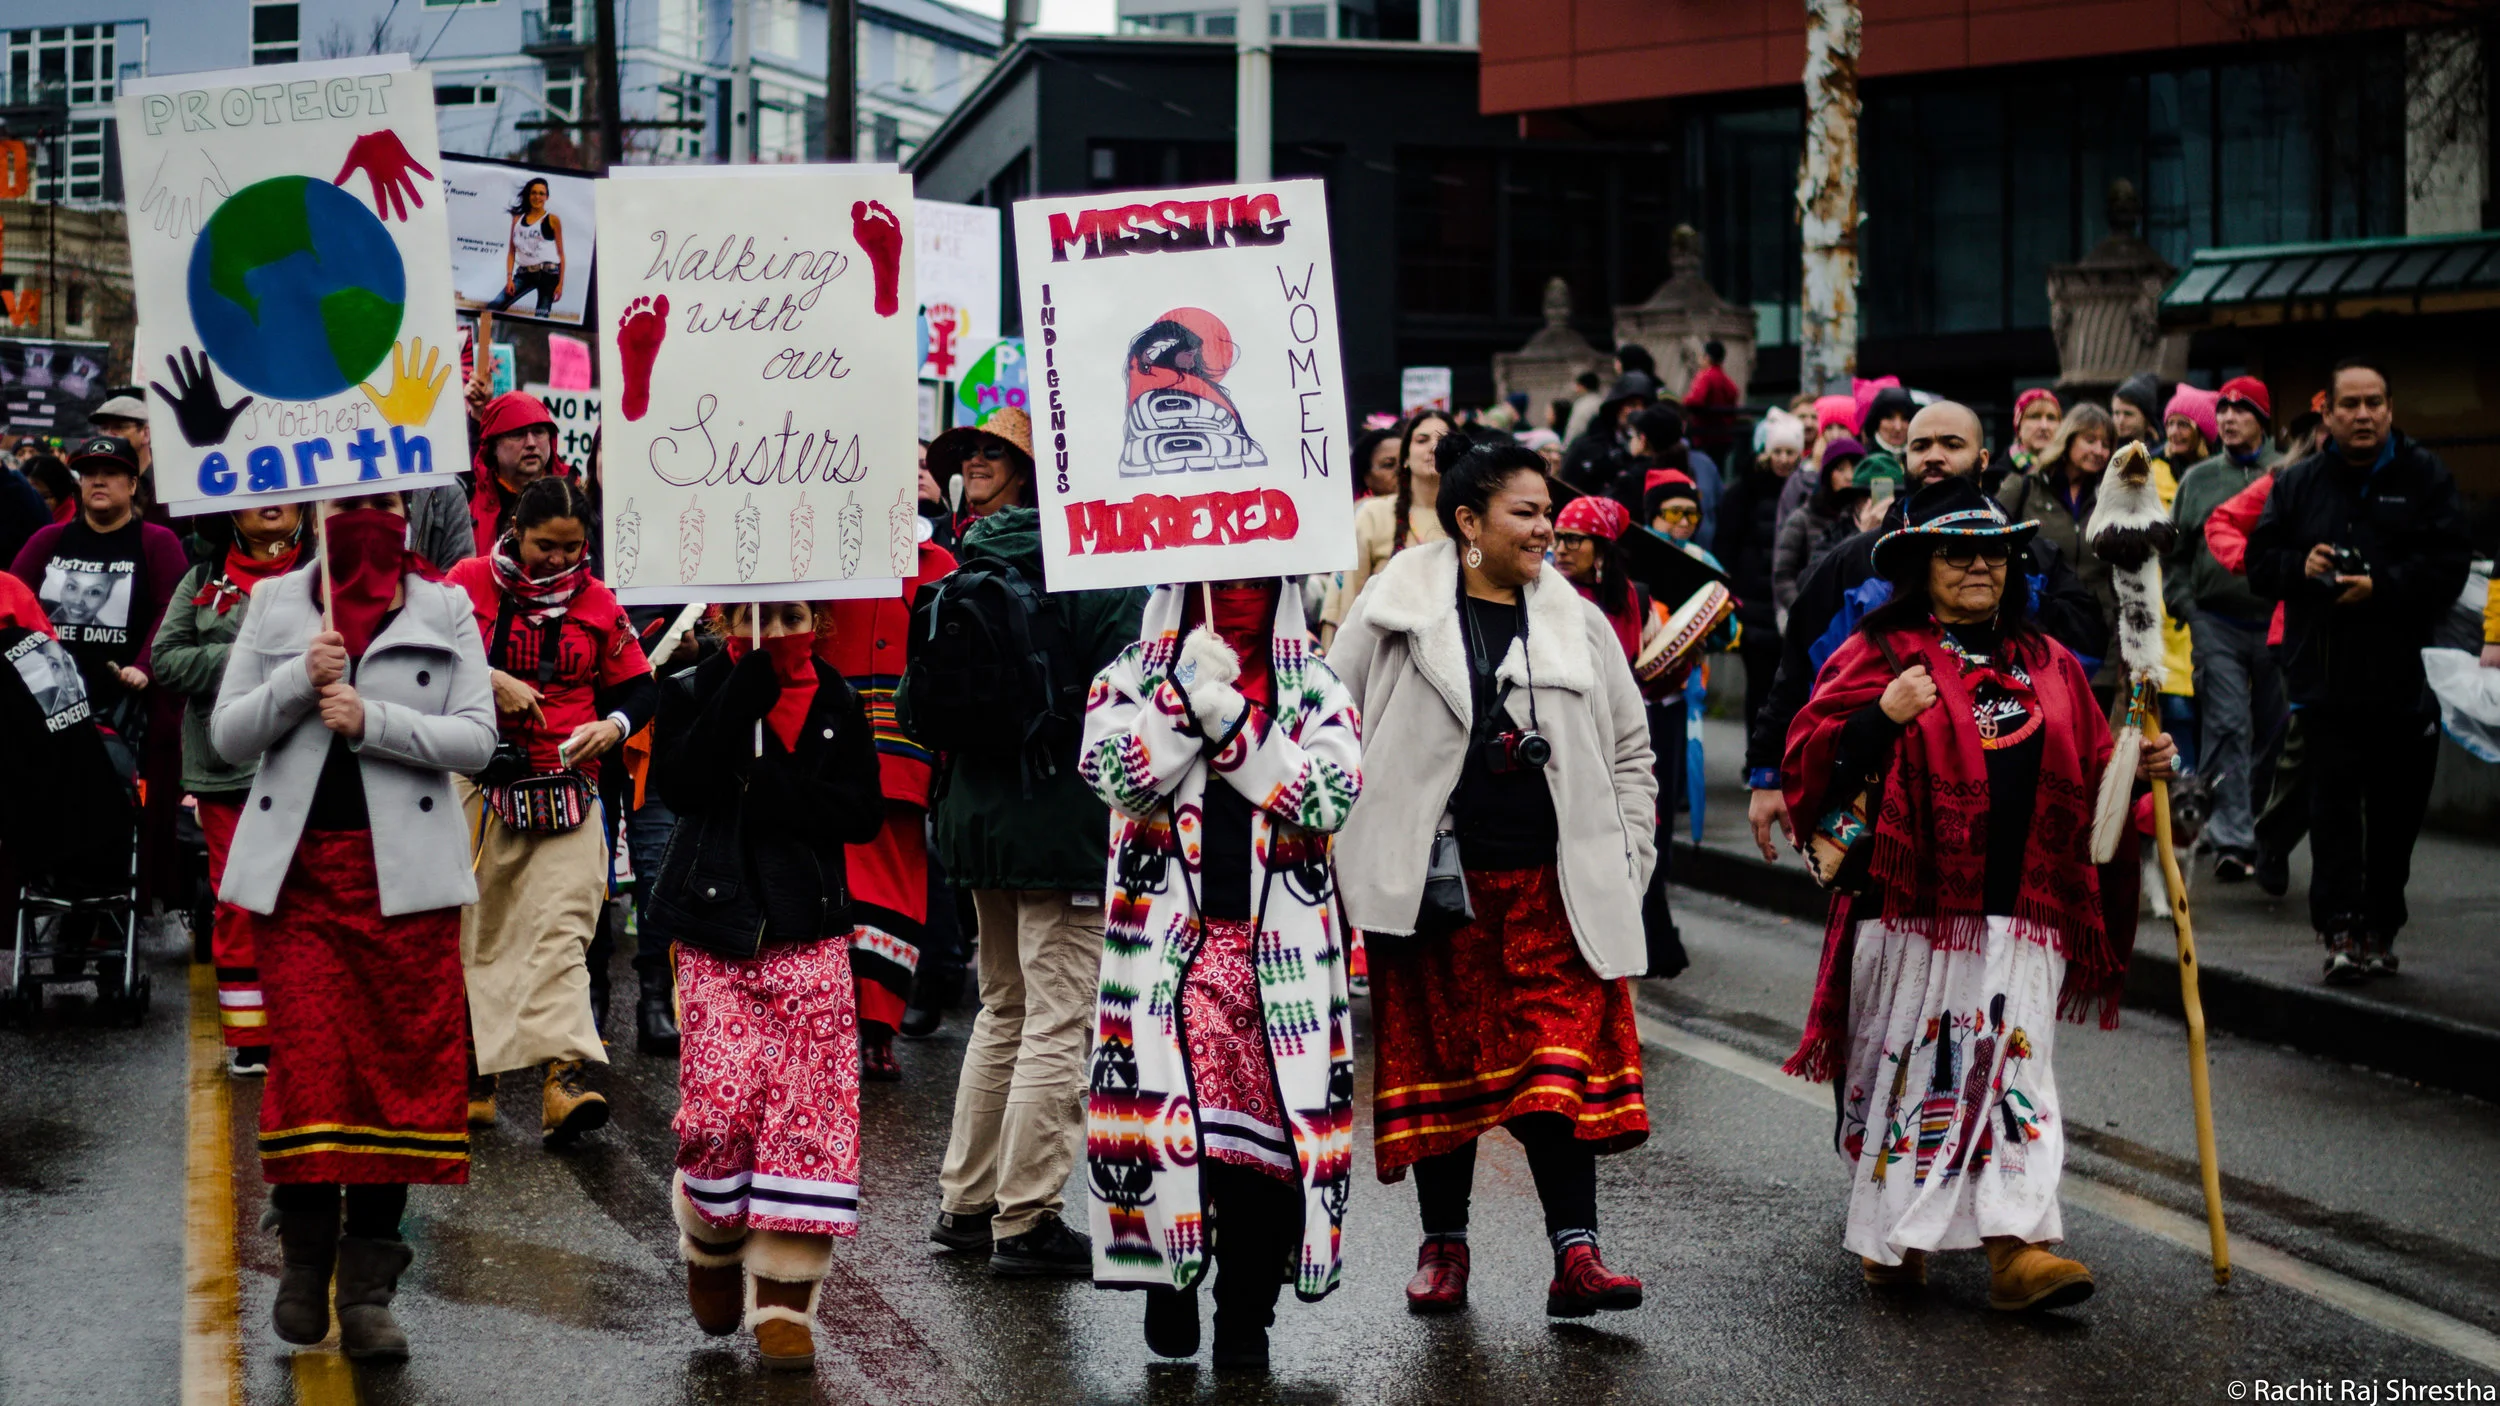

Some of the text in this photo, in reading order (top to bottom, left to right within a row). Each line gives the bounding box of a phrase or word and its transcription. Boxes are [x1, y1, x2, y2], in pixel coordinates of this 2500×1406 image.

[142, 73, 393, 136] PROTECT
[1047, 193, 1291, 263] MISSING
[643, 230, 849, 311] Walking
[687, 293, 804, 334] with
[761, 346, 851, 381] our
[1040, 284, 1071, 495] INDIGENOUS
[1275, 261, 1330, 480] WOMEN
[243, 400, 372, 440] Mother
[648, 393, 868, 487] Sisters
[197, 424, 434, 496] earth
[1063, 486, 1300, 557] MURDERED
[50, 556, 136, 574] JUSTICE FOR
[54, 625, 128, 644] NEE DAVIS
